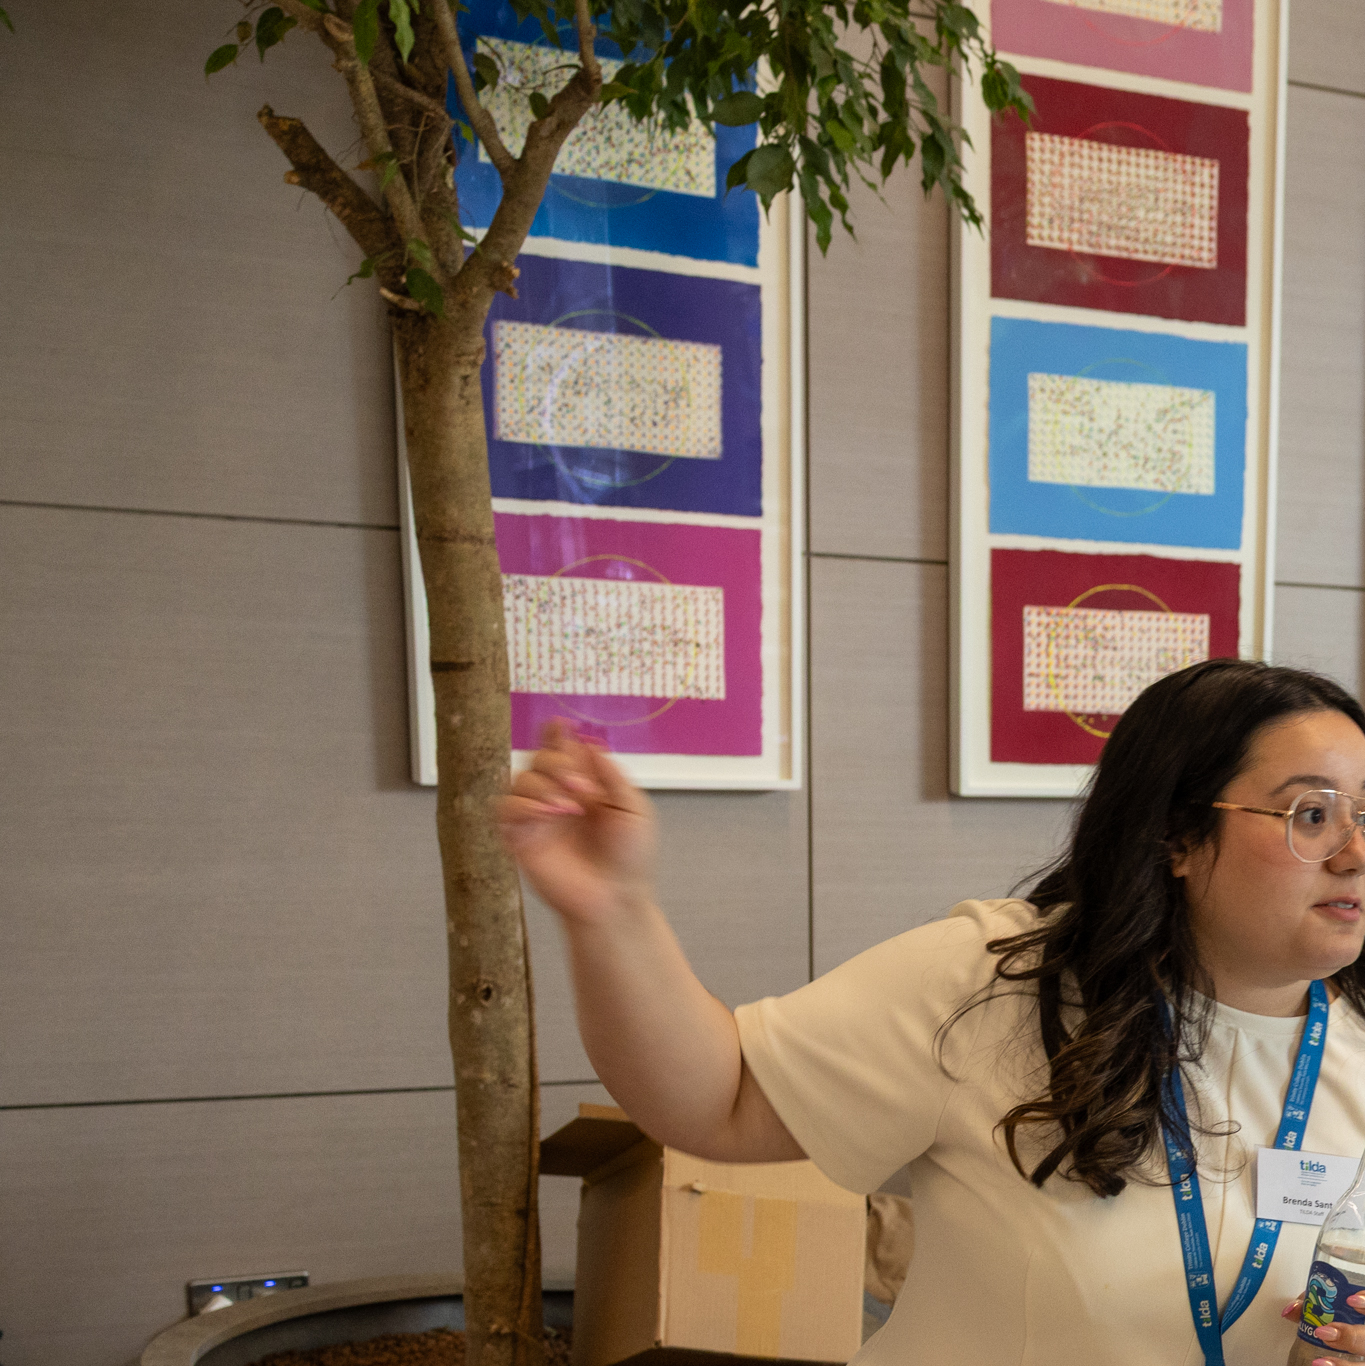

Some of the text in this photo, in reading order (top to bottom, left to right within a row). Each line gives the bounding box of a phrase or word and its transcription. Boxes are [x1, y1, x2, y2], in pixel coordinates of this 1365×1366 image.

[1308, 1022, 1323, 1046] tilda
[1300, 1160, 1326, 1173] tilda
[1180, 1173, 1193, 1201] tilda
[1283, 1196, 1312, 1207] Brenda
[1252, 1242, 1268, 1269] tilda
[1200, 1299, 1212, 1328] tilda
